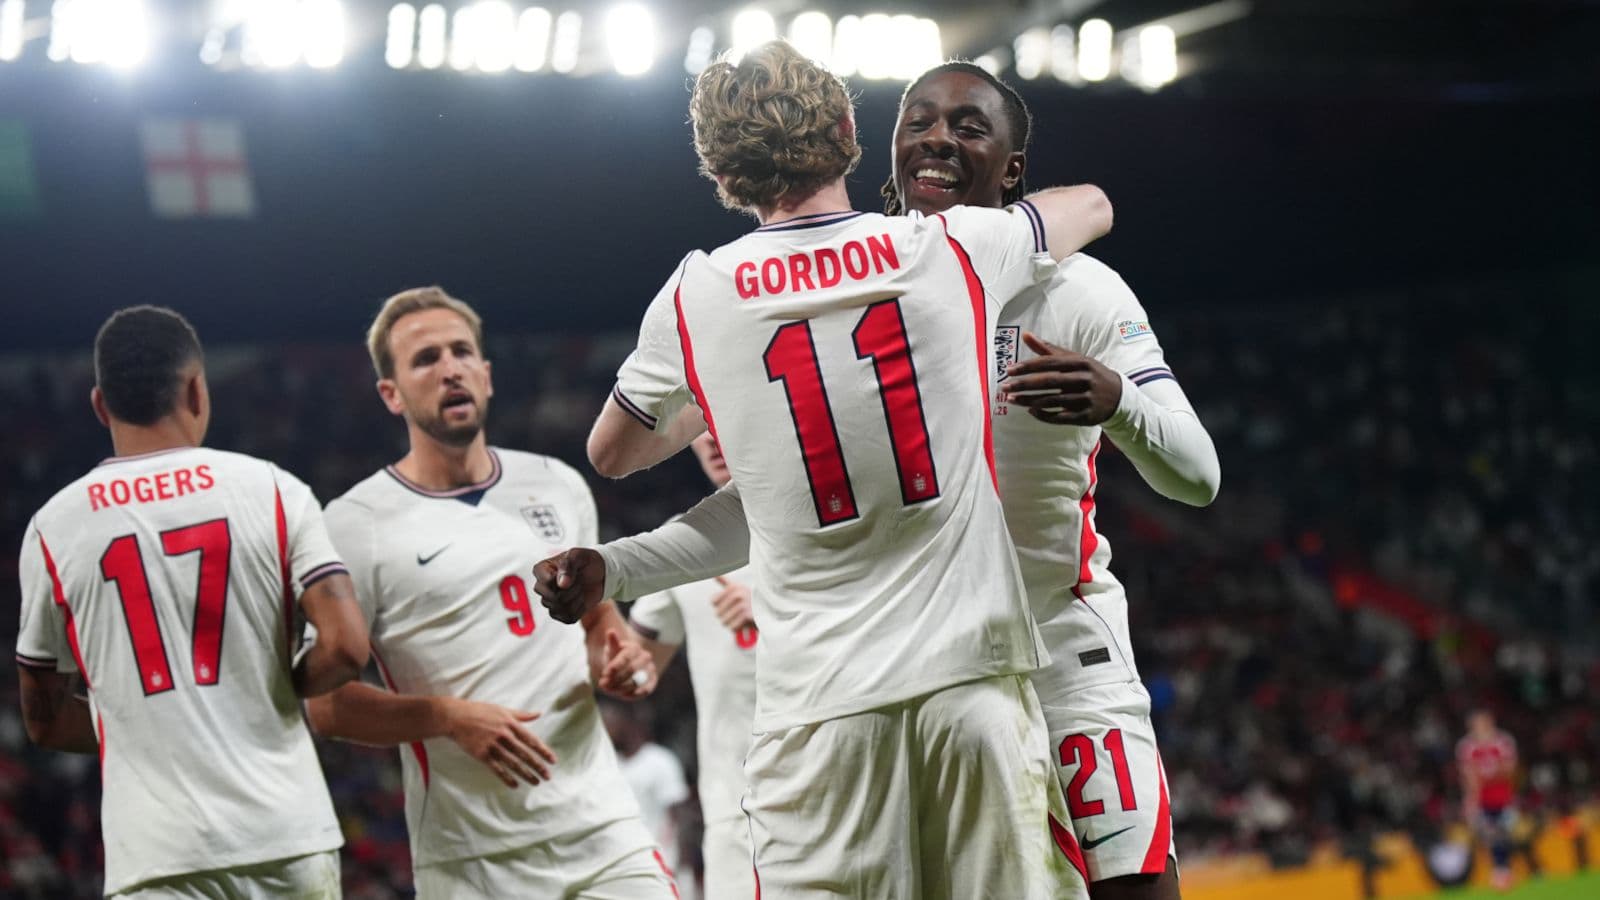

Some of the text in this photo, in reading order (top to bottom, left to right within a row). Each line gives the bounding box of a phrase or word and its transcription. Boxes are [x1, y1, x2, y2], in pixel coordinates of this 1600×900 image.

[735, 233, 900, 300] GORDON
[762, 297, 941, 528] 11
[87, 464, 215, 512] ROGERS
[99, 517, 232, 697] 17
[498, 574, 536, 637] 9
[1058, 728, 1138, 820] 21
